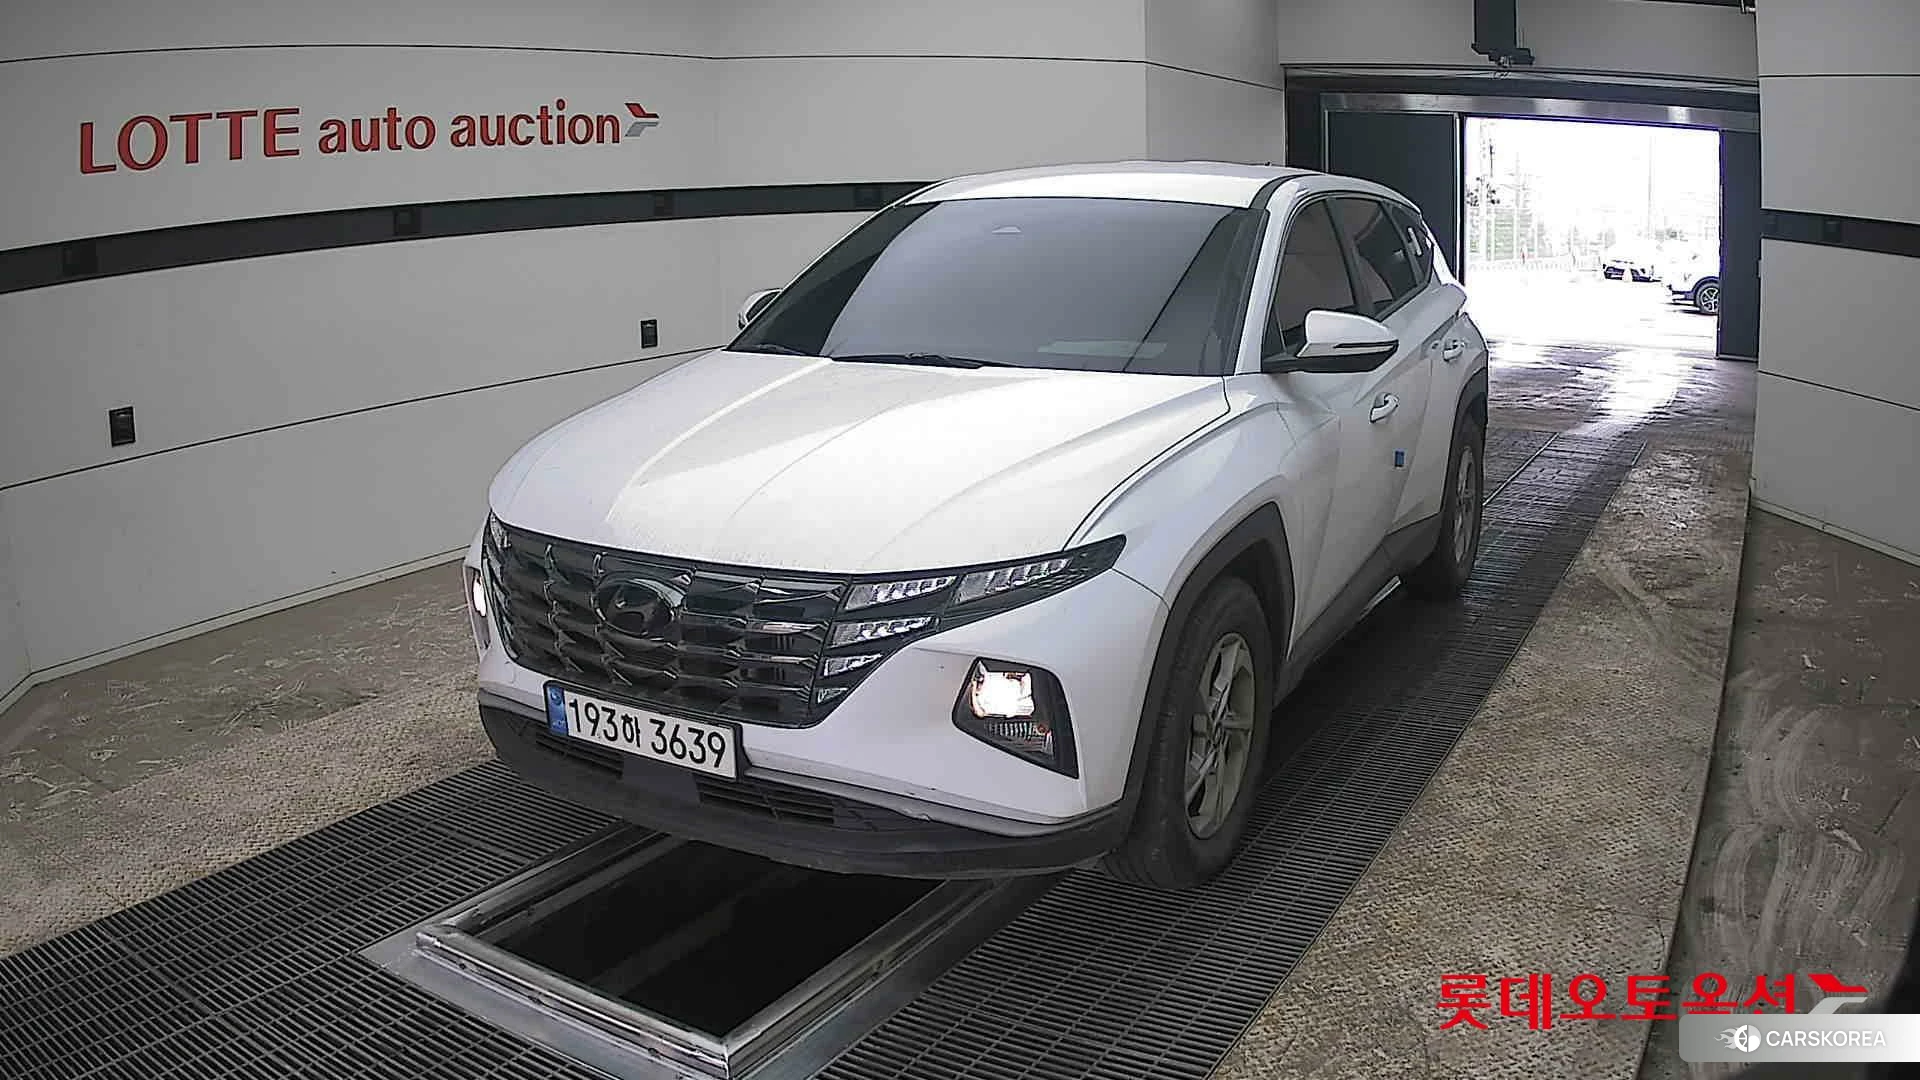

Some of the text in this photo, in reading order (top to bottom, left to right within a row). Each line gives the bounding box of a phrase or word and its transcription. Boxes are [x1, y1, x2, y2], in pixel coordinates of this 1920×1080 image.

[79, 99, 621, 174] LOTTE auto auction
[569, 699, 726, 768] 193하 3639
